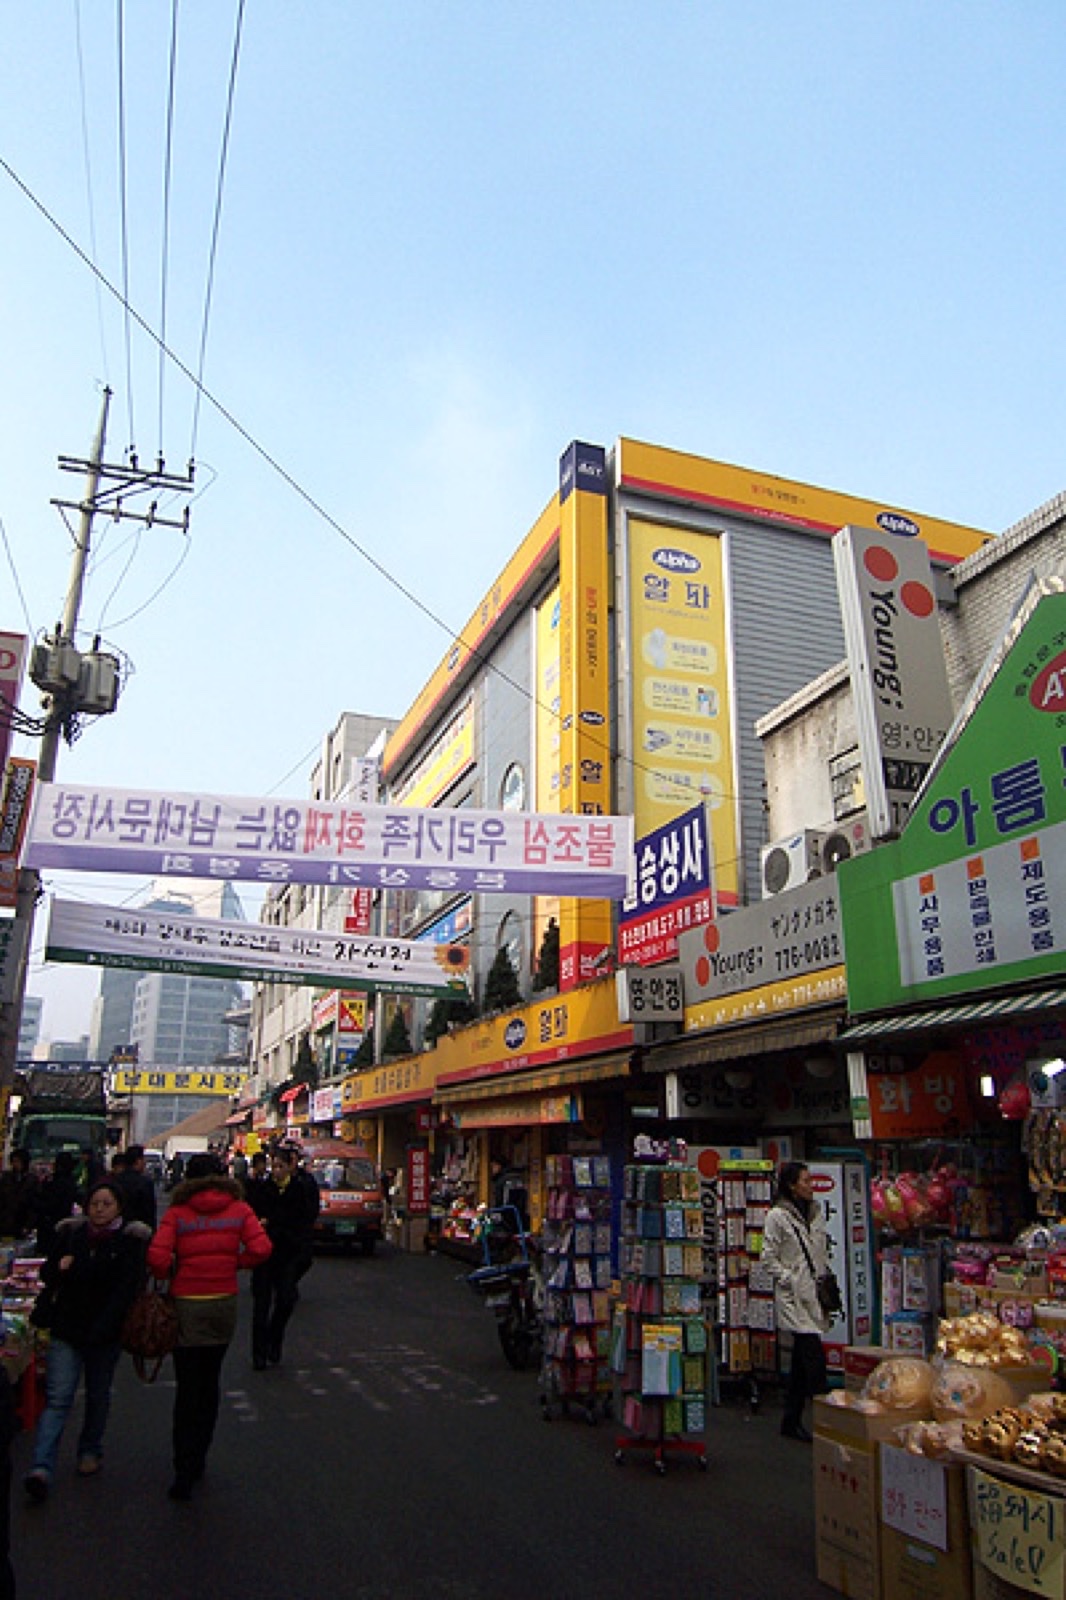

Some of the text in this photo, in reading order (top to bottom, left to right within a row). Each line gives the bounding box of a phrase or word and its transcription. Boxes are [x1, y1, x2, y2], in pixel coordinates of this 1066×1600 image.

[878, 514, 919, 536] Alpha
[655, 550, 700, 573] Alpha
[124, 1072, 241, 1089] 남대문시장
[878, 1074, 956, 1114] 화방
